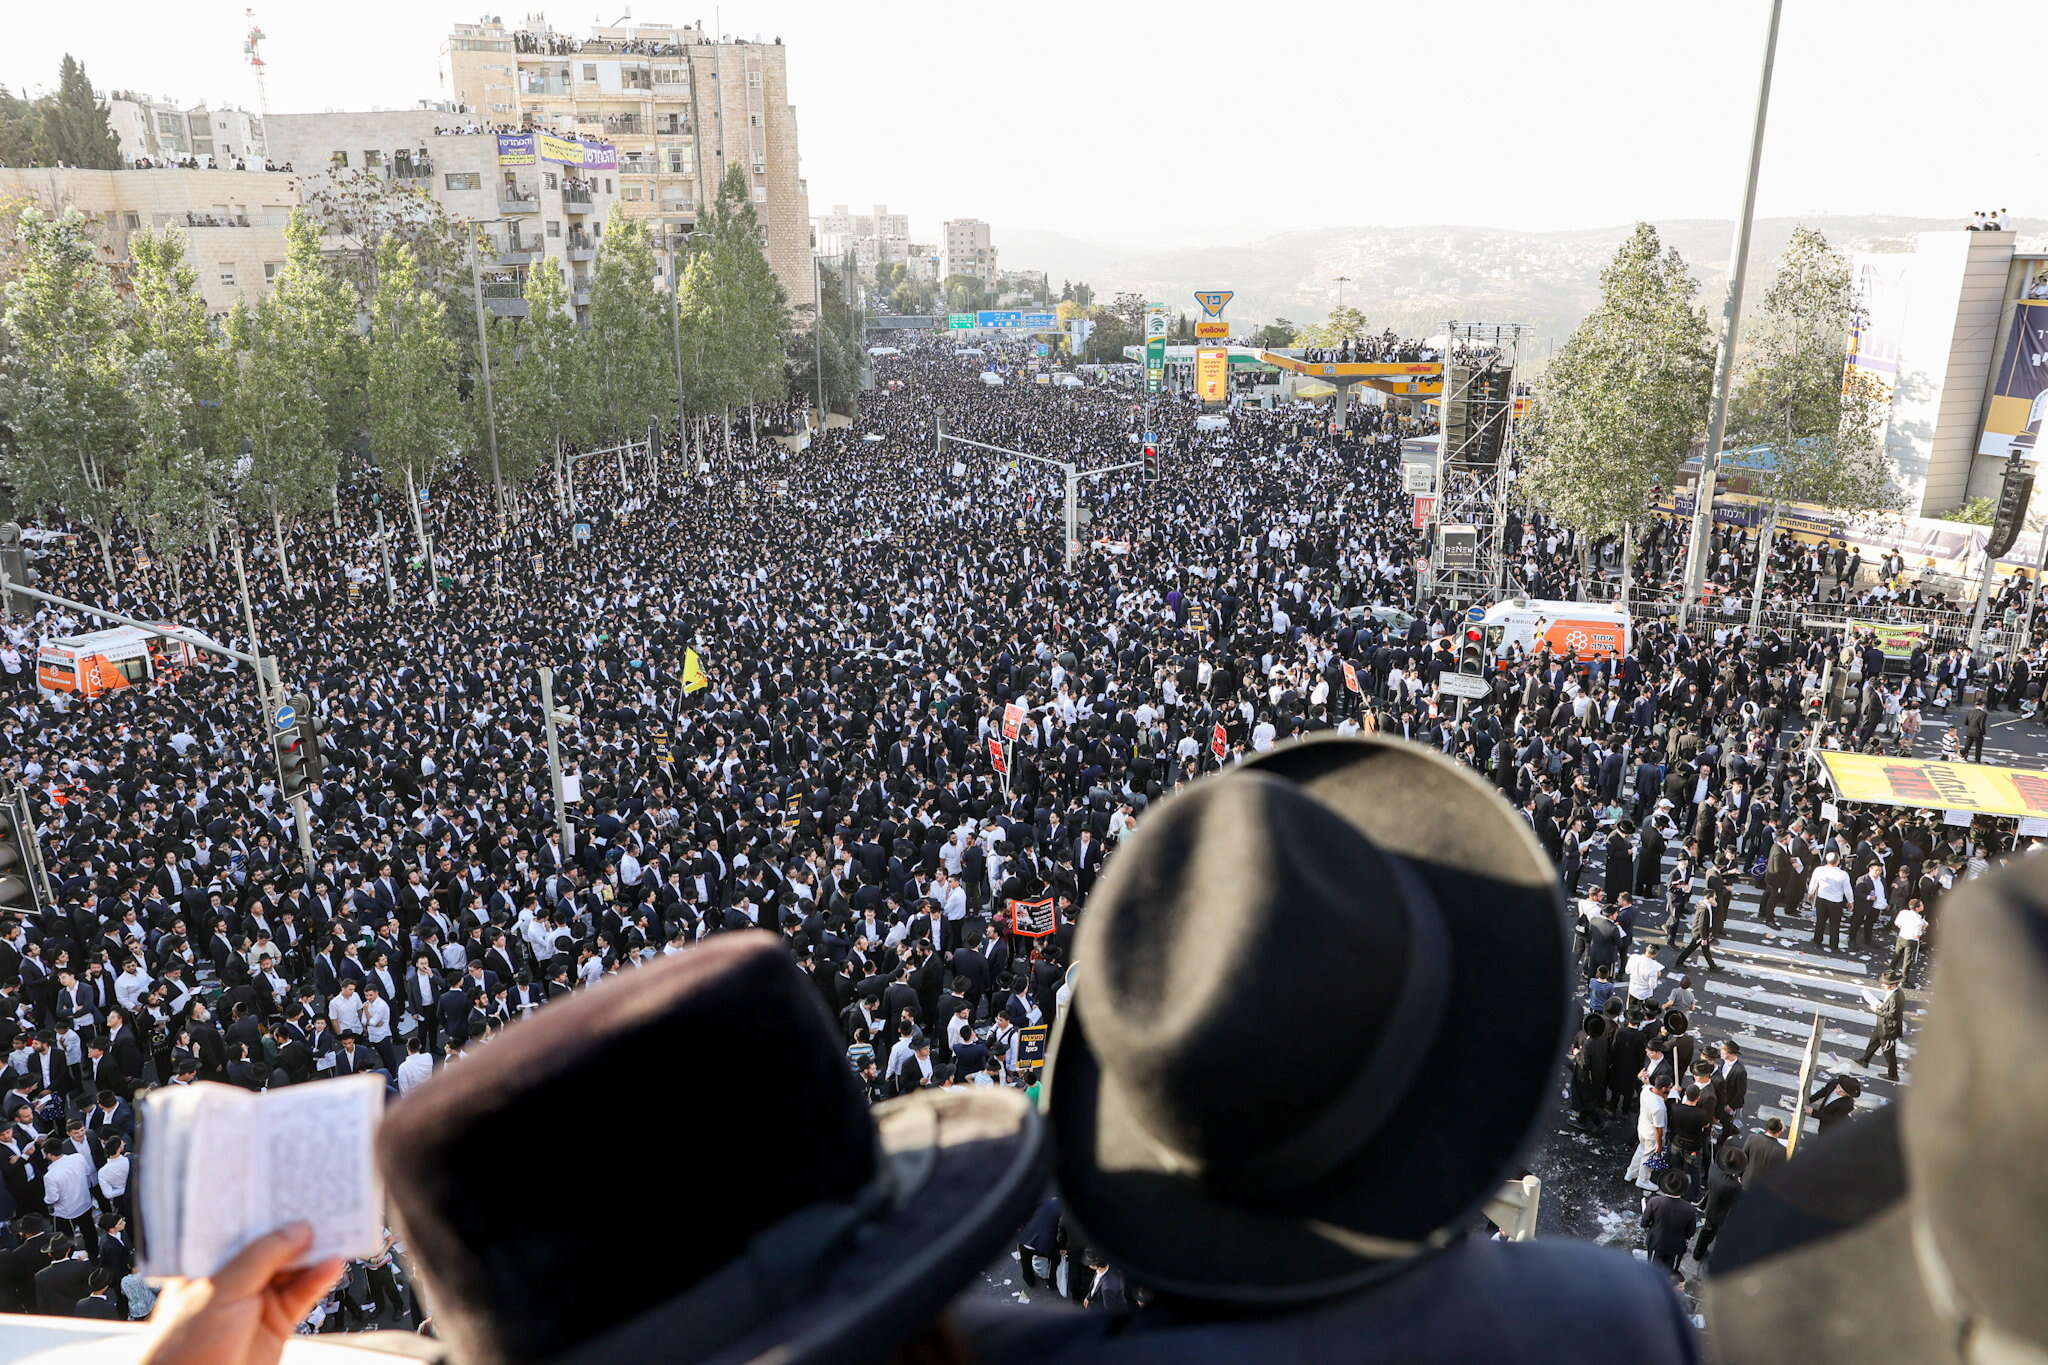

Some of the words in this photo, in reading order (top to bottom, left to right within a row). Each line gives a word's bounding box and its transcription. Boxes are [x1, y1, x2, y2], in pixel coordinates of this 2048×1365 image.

[1200, 326, 1227, 335] yellow
[1810, 522, 1830, 532] אנחנו
[1445, 545, 1473, 553] RENEW
[1591, 634, 1616, 642] איחוד
